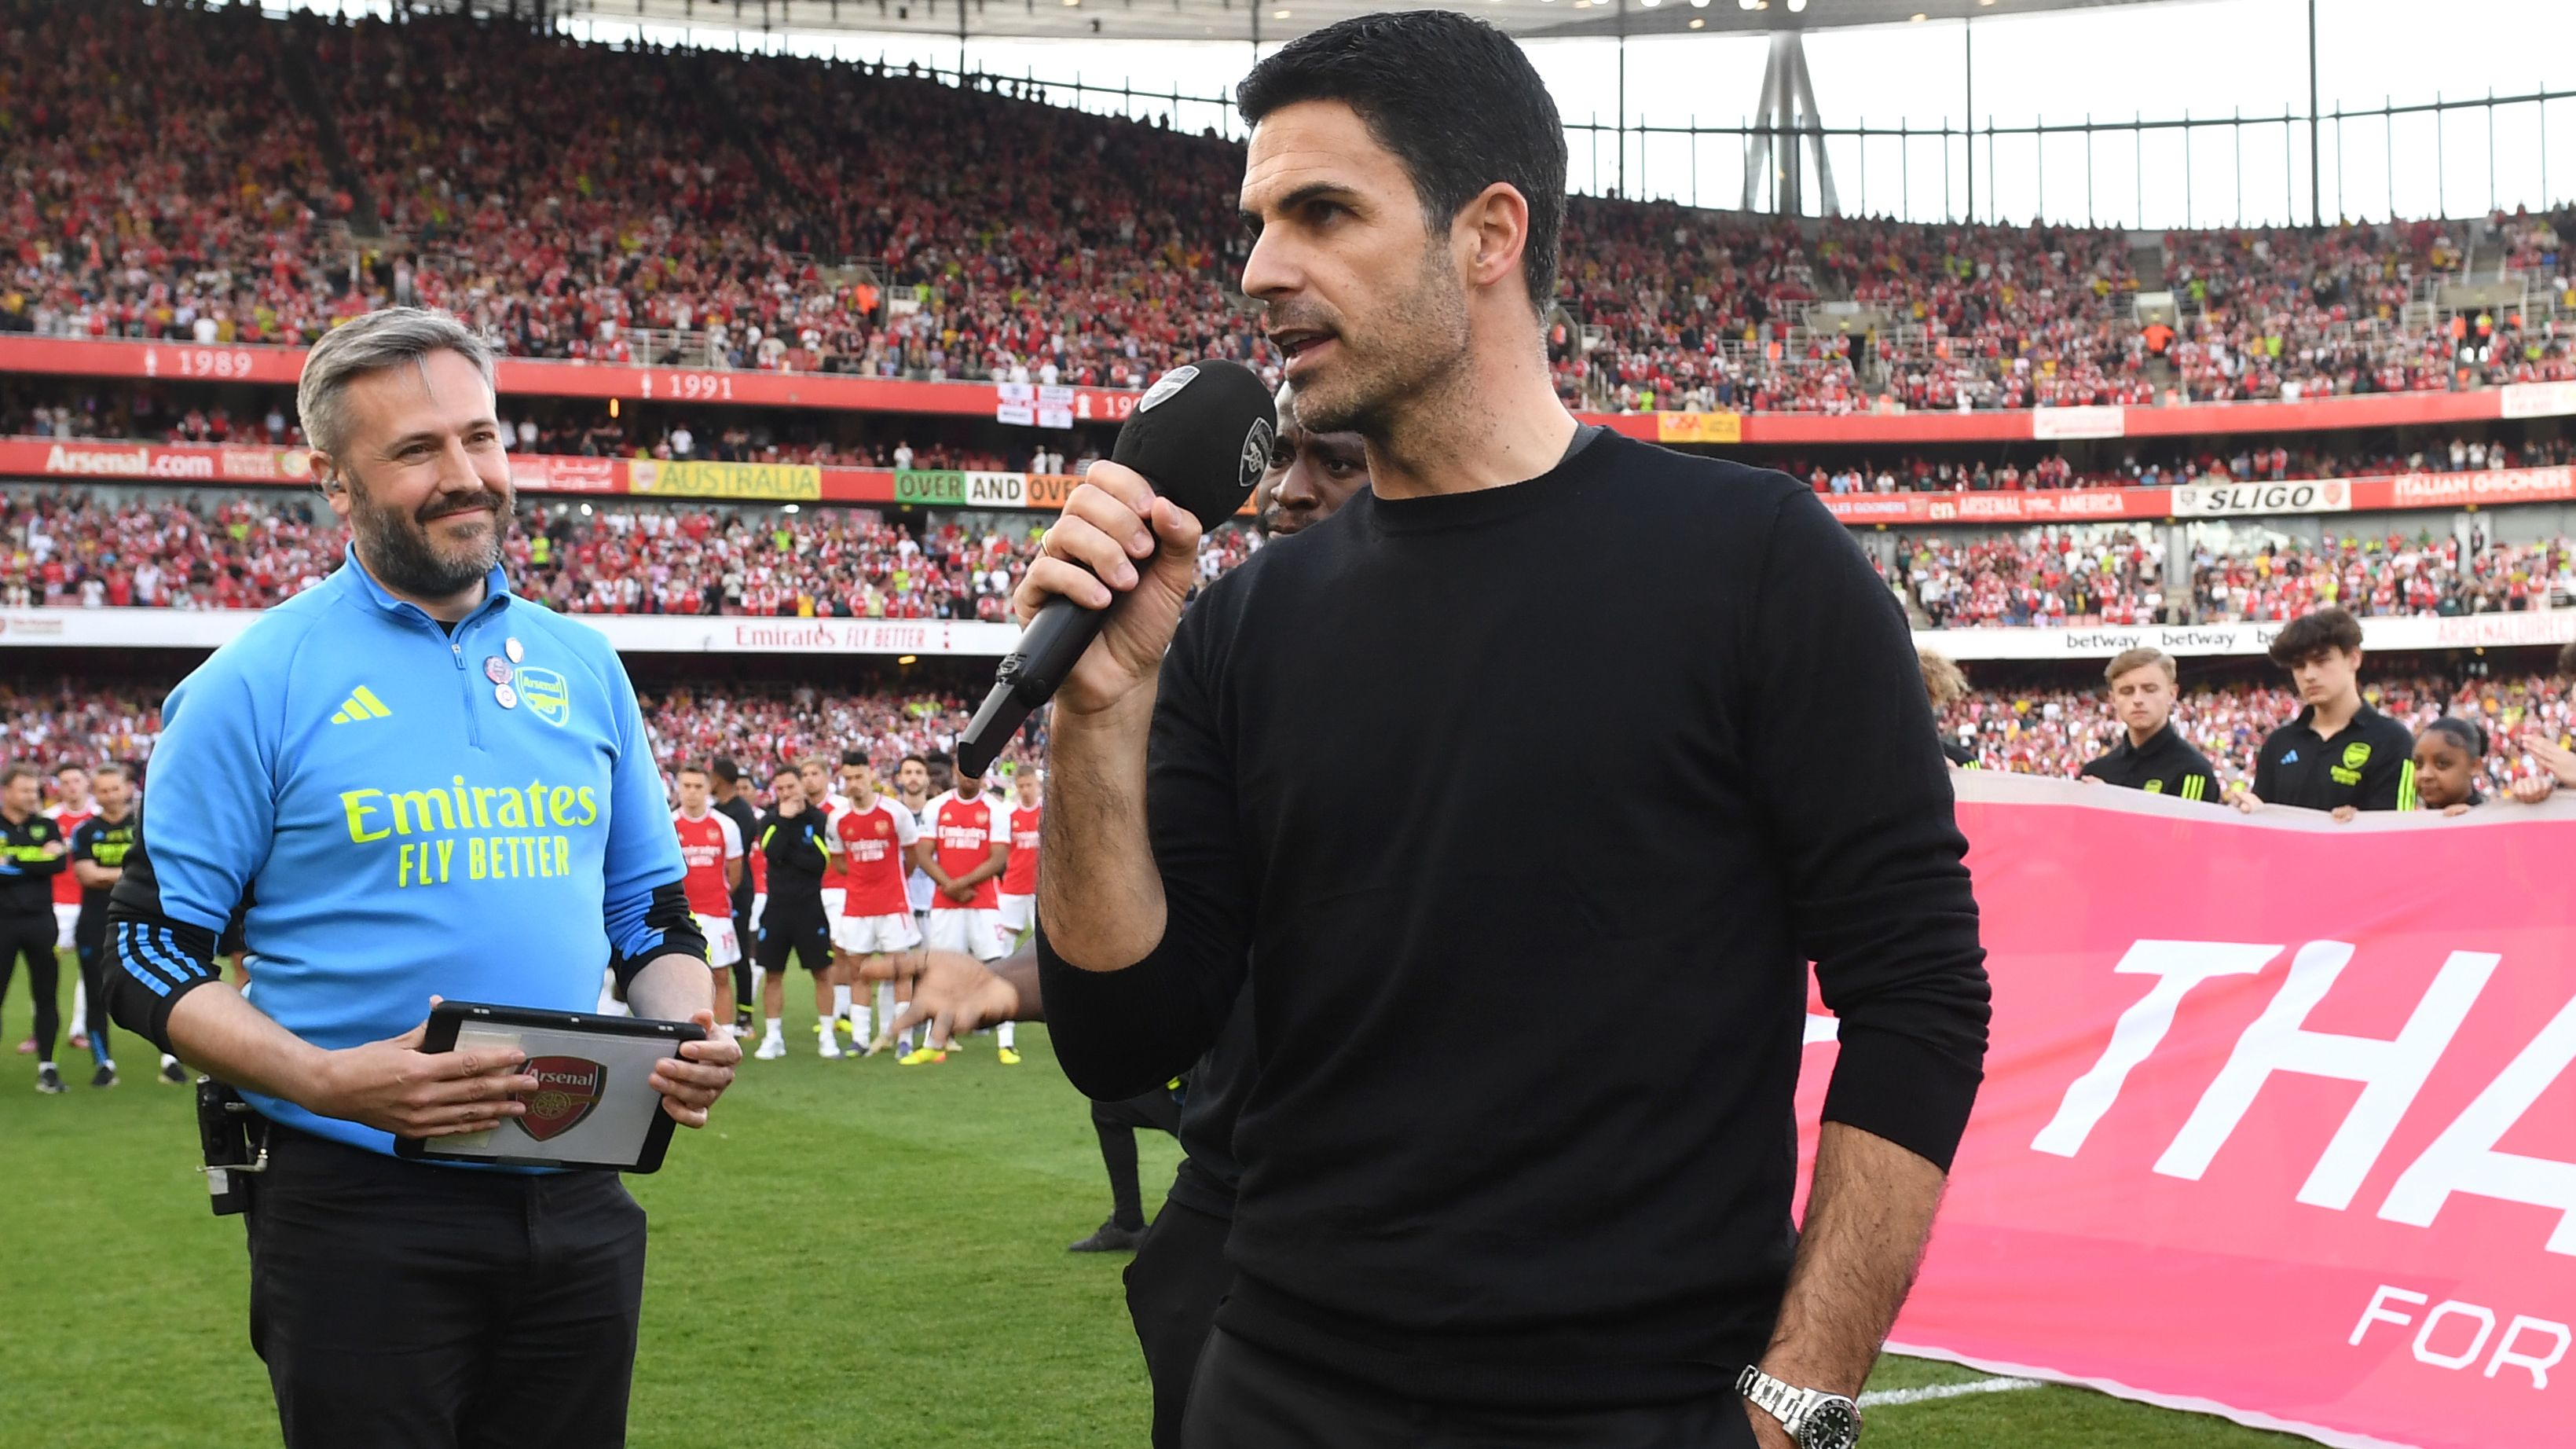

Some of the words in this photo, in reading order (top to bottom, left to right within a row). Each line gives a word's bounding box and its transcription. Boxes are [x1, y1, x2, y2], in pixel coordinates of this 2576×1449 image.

[179, 350, 253, 378] 1989
[669, 373, 732, 399] 1991
[46, 445, 213, 477] Arsenal.com
[660, 465, 818, 496] AUSTRALIA
[900, 474, 962, 497] OVER
[973, 477, 1021, 501] AND
[1030, 478, 1086, 501] OVE
[2395, 475, 2469, 496] ITALIAN
[2207, 486, 2314, 511] SLIGO
[735, 623, 836, 647] Emirates
[845, 626, 868, 647] FLY
[874, 627, 925, 648] BETTER
[2066, 633, 2141, 648] betway
[2161, 630, 2237, 647] betway
[523, 676, 561, 693] Arsenal
[339, 775, 598, 844] Emirates
[398, 839, 454, 888] FLY
[469, 835, 570, 880] BETTER
[529, 1068, 594, 1087] Arsenal
[2348, 1284, 2572, 1391] FOR
